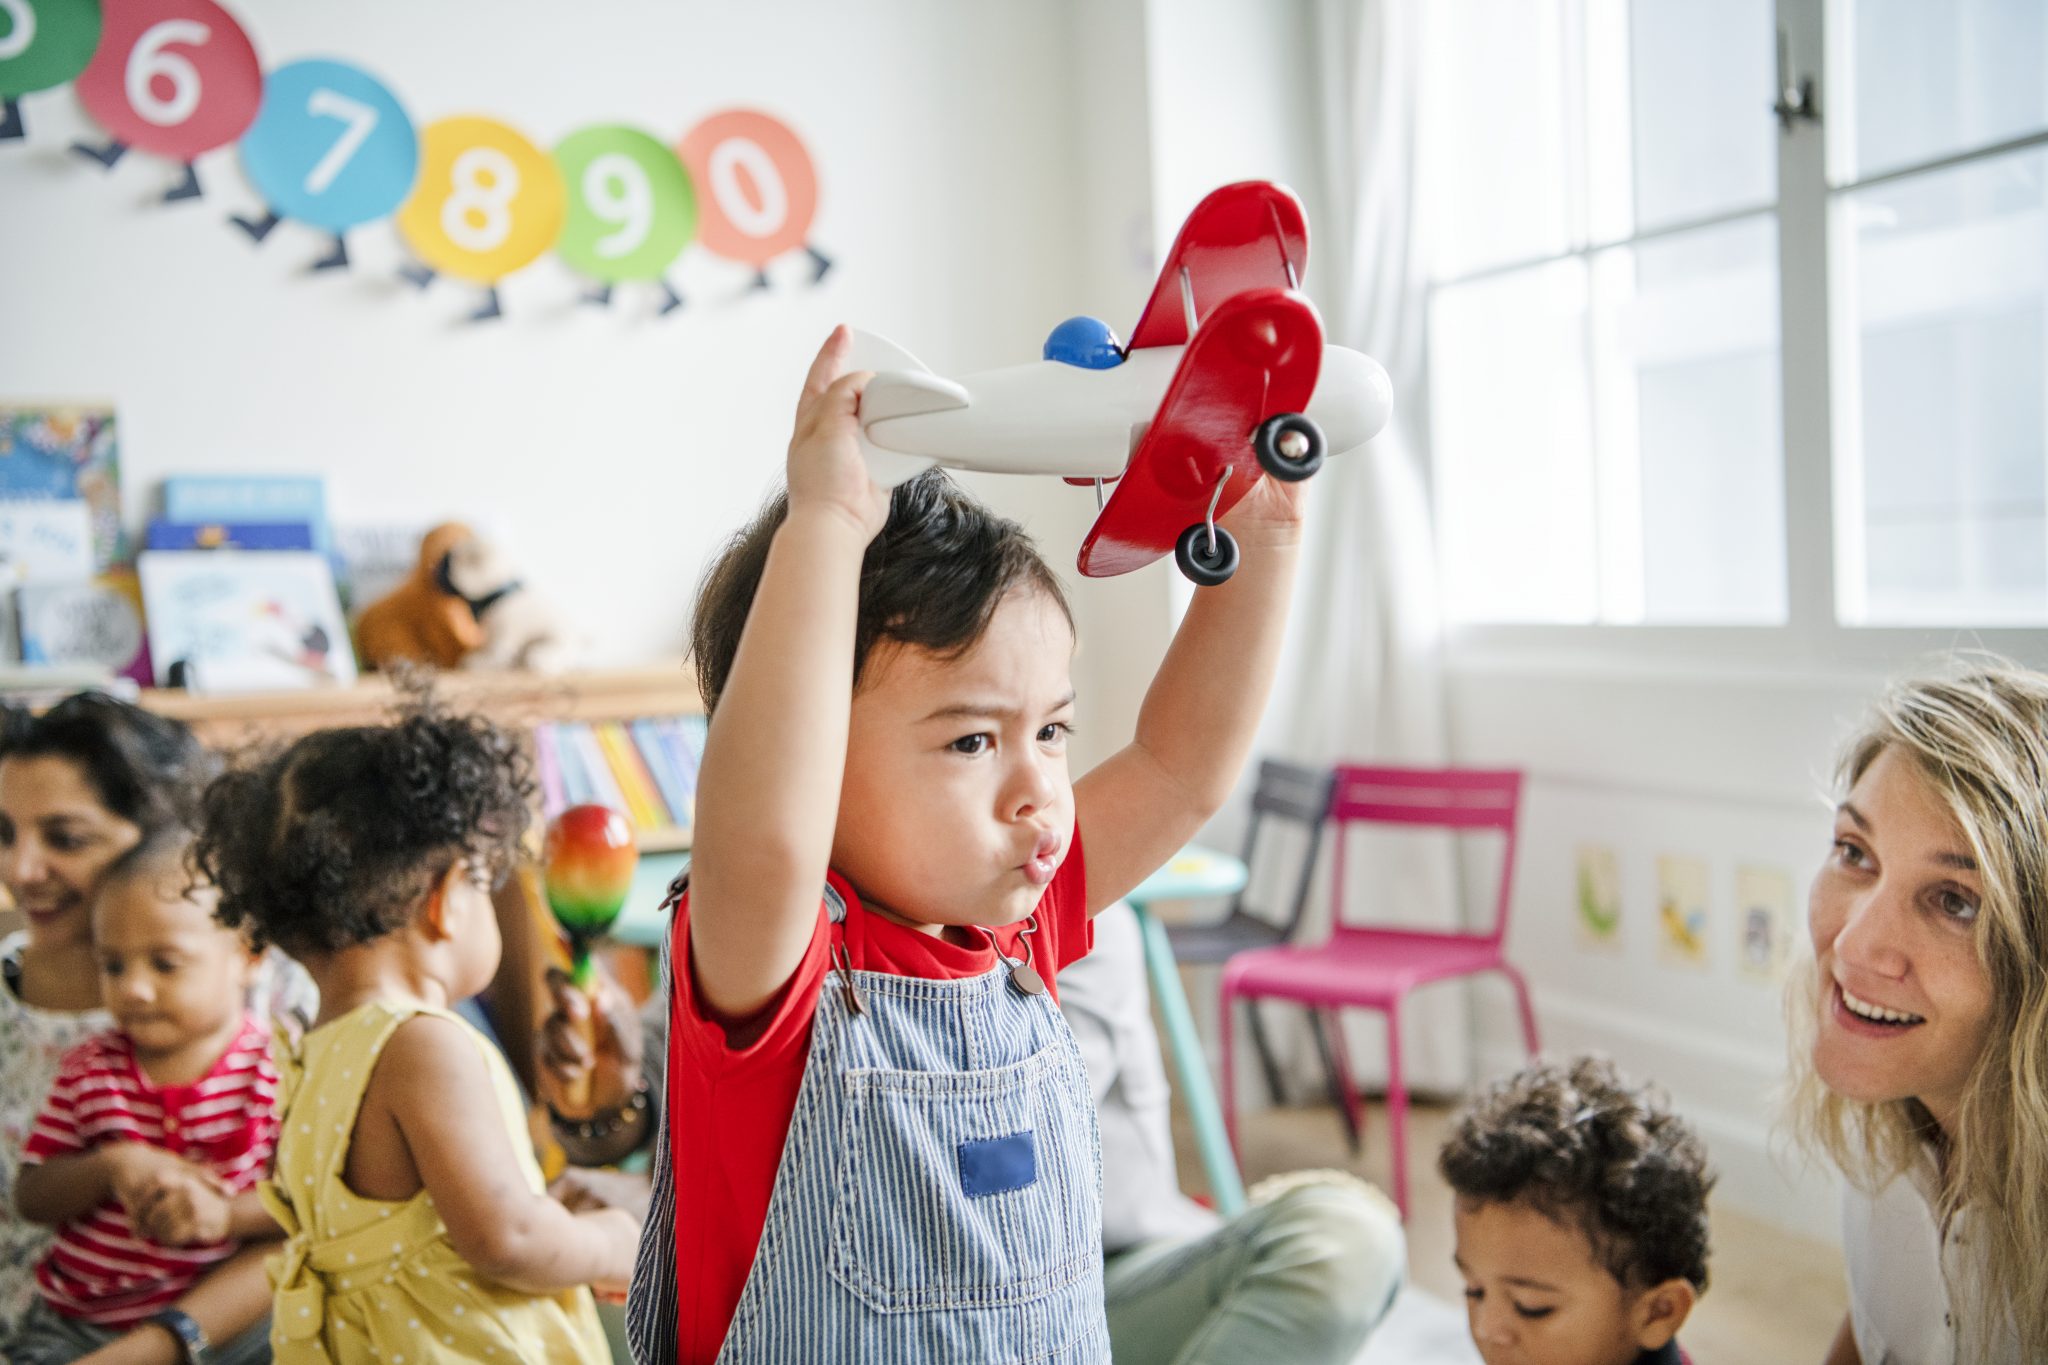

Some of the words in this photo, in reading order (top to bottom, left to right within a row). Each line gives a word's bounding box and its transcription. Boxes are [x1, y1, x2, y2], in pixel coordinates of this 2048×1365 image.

[125, 20, 210, 125] 6
[306, 88, 379, 194] 7
[441, 147, 519, 252] 8
[582, 154, 655, 258] 9
[709, 138, 788, 237] 0
